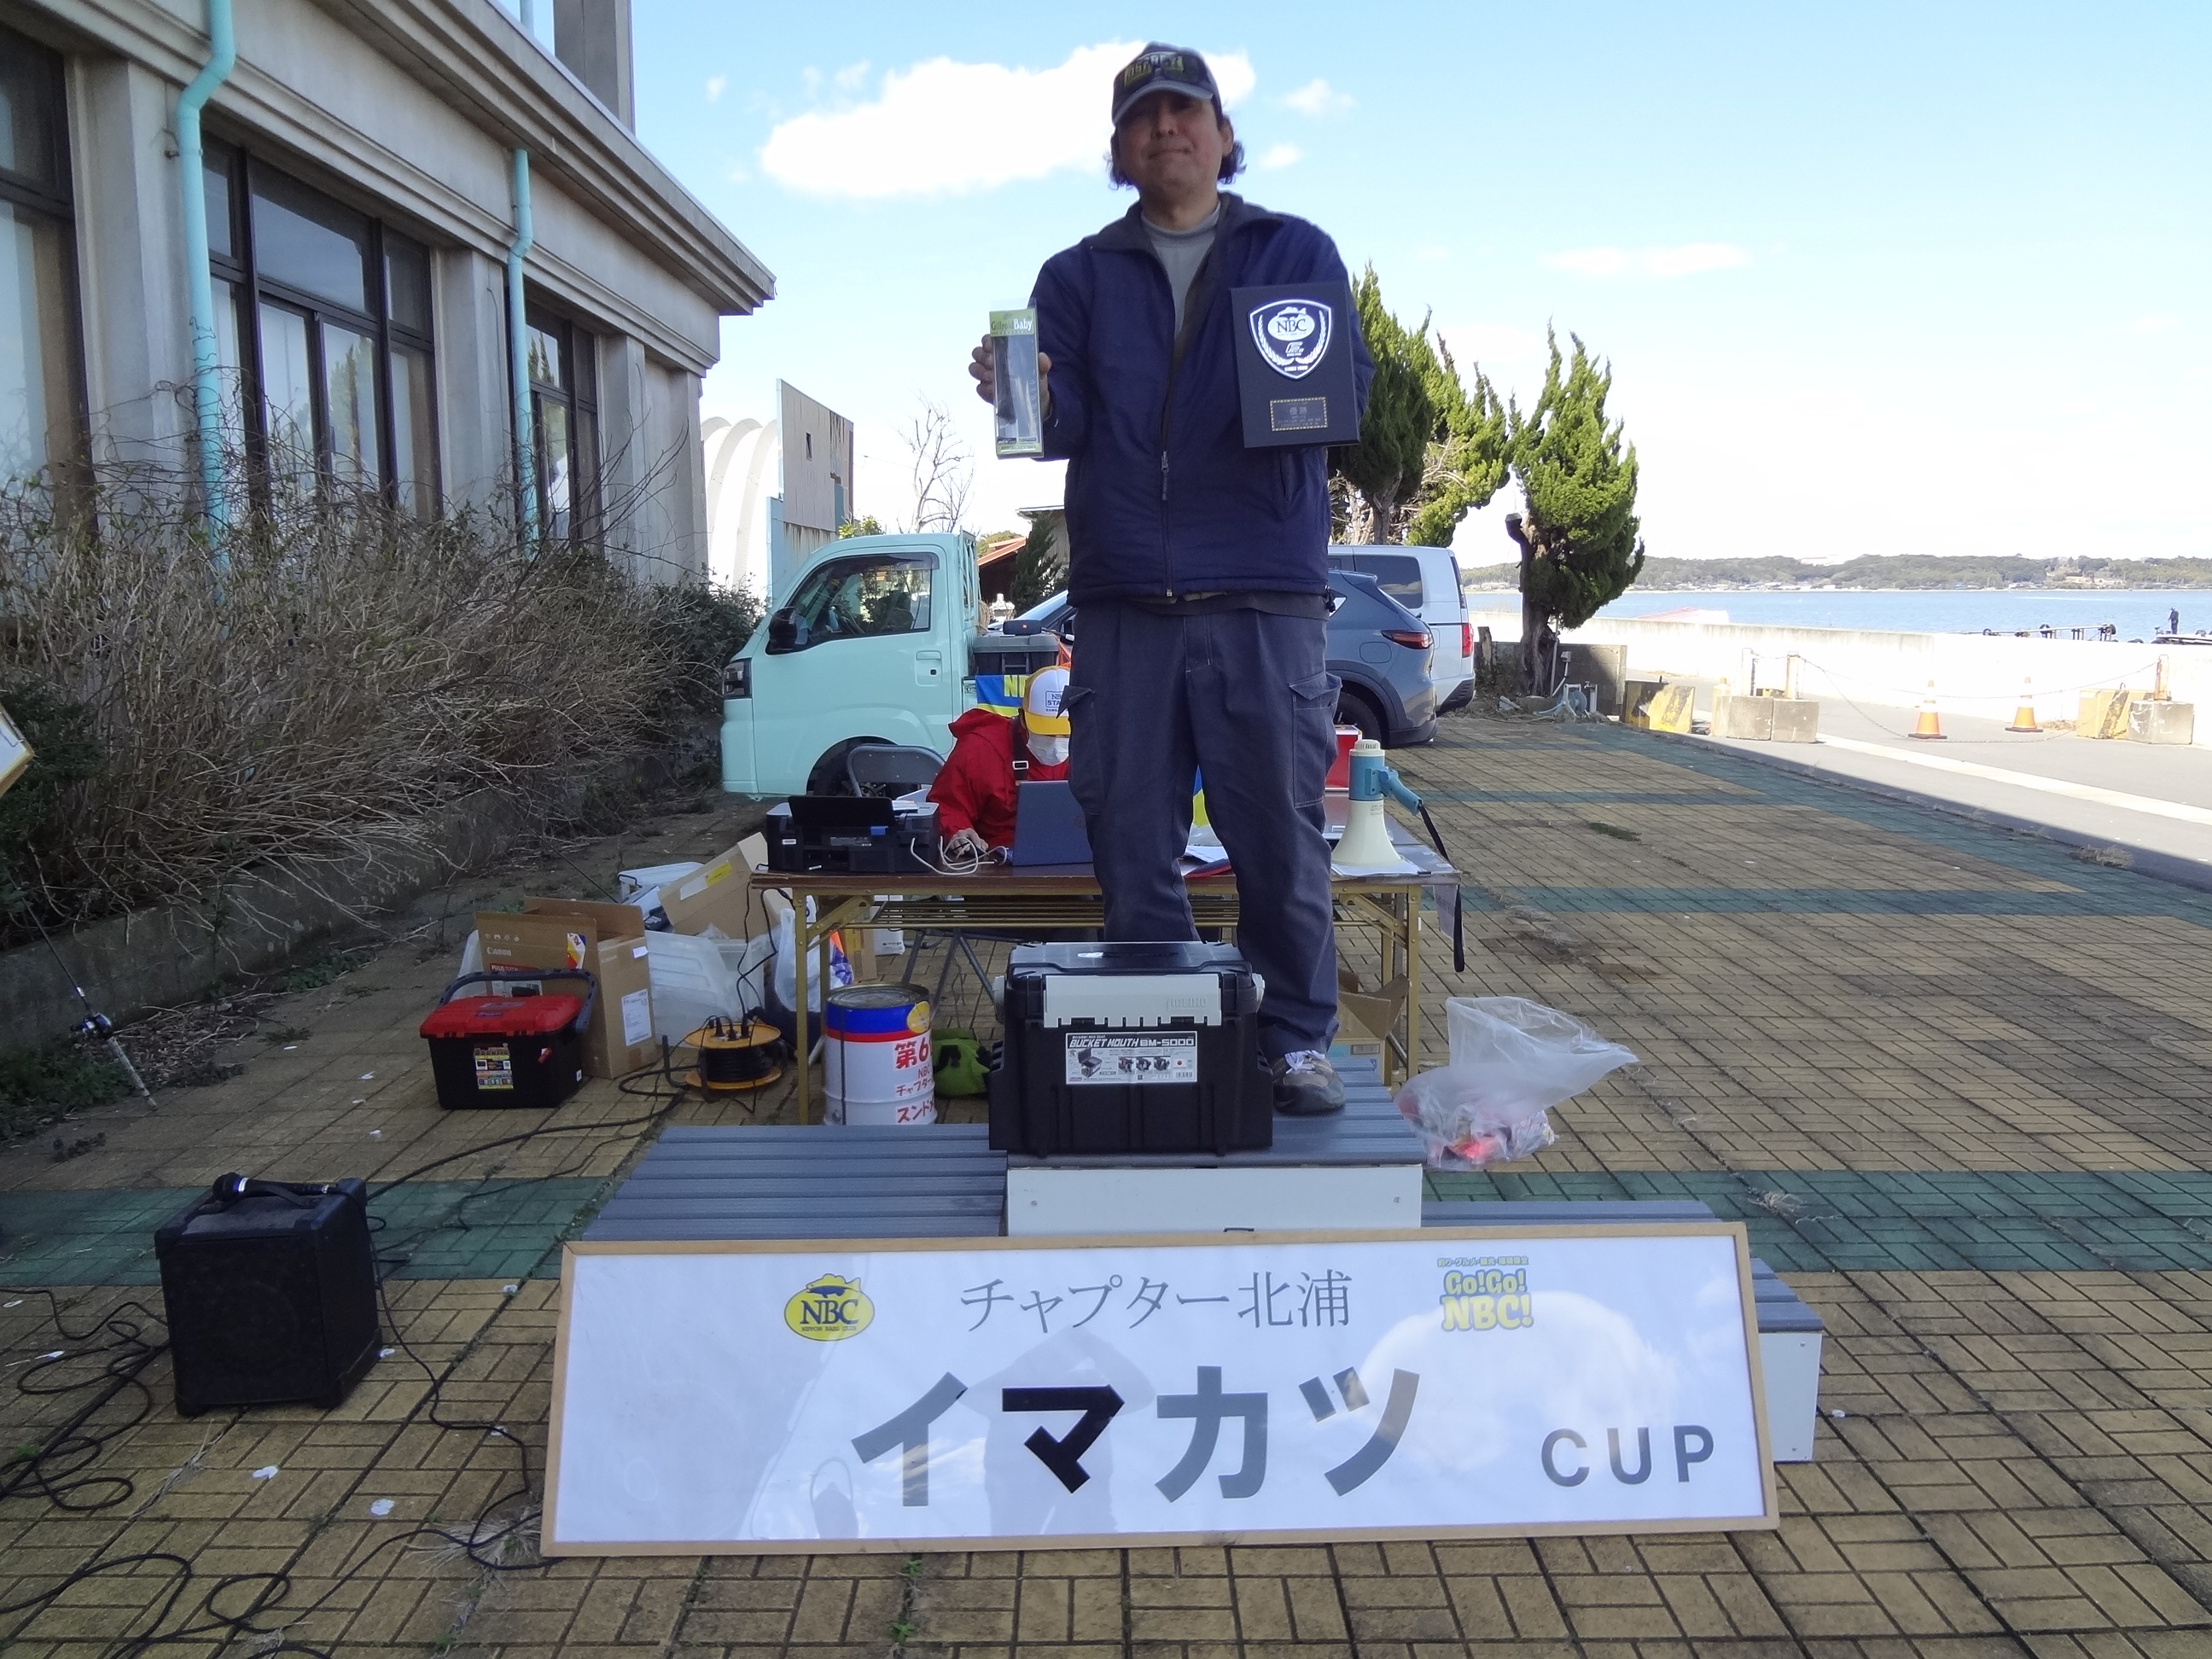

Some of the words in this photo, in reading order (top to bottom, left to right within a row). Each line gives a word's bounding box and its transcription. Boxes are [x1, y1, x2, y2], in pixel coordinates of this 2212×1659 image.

[1276, 318, 1307, 333] NBC
[486, 946, 512, 957] Canon
[1069, 1039, 1108, 1048] BUCKET
[1107, 1038, 1139, 1047] MOUTH
[1442, 1268, 1528, 1295] Go!Go!
[800, 1299, 859, 1324] NBC
[960, 1269, 1353, 1334] チャプター北浦
[1440, 1292, 1534, 1331] NBC!
[850, 1365, 1420, 1508] イマカツ
[1540, 1424, 1714, 1487] CUP
